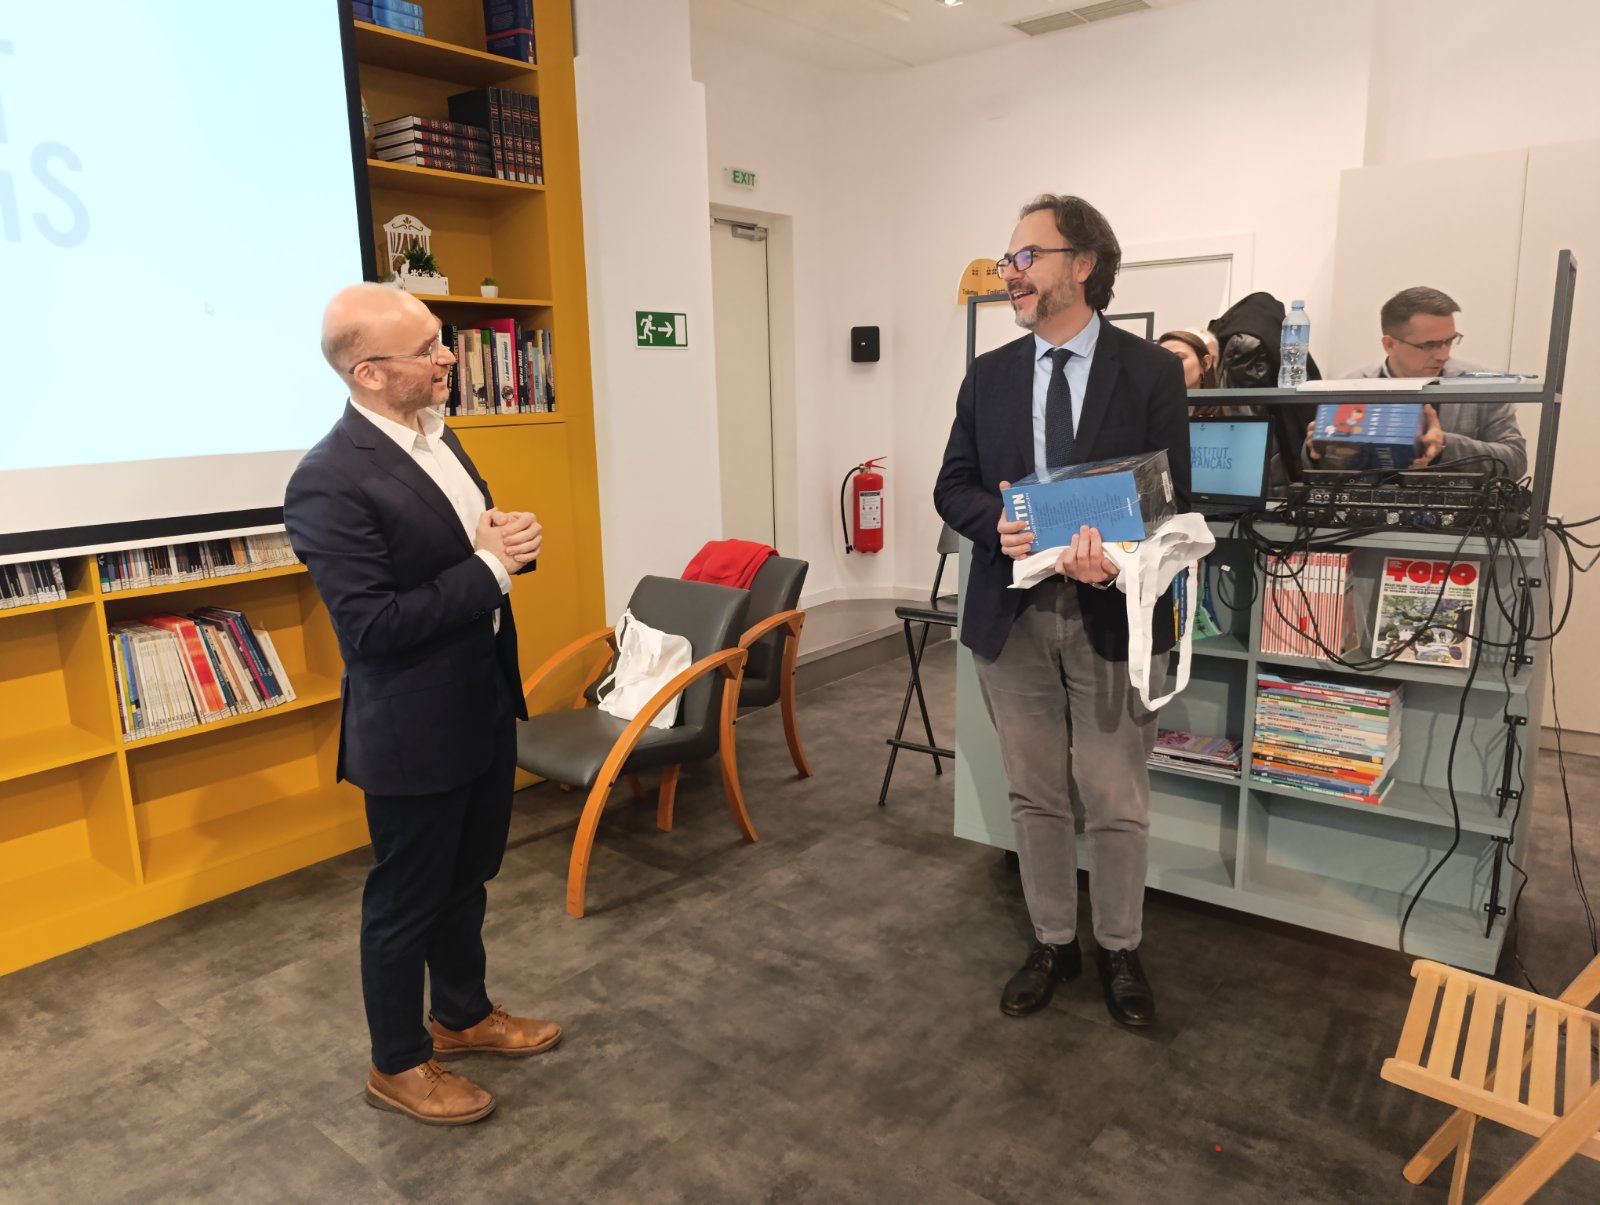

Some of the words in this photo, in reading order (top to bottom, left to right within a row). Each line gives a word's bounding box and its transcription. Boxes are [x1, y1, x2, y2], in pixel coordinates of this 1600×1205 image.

[732, 170, 756, 188] EXIT
[1190, 446, 1228, 459] NSTITUT
[1386, 559, 1477, 586] TOPO
